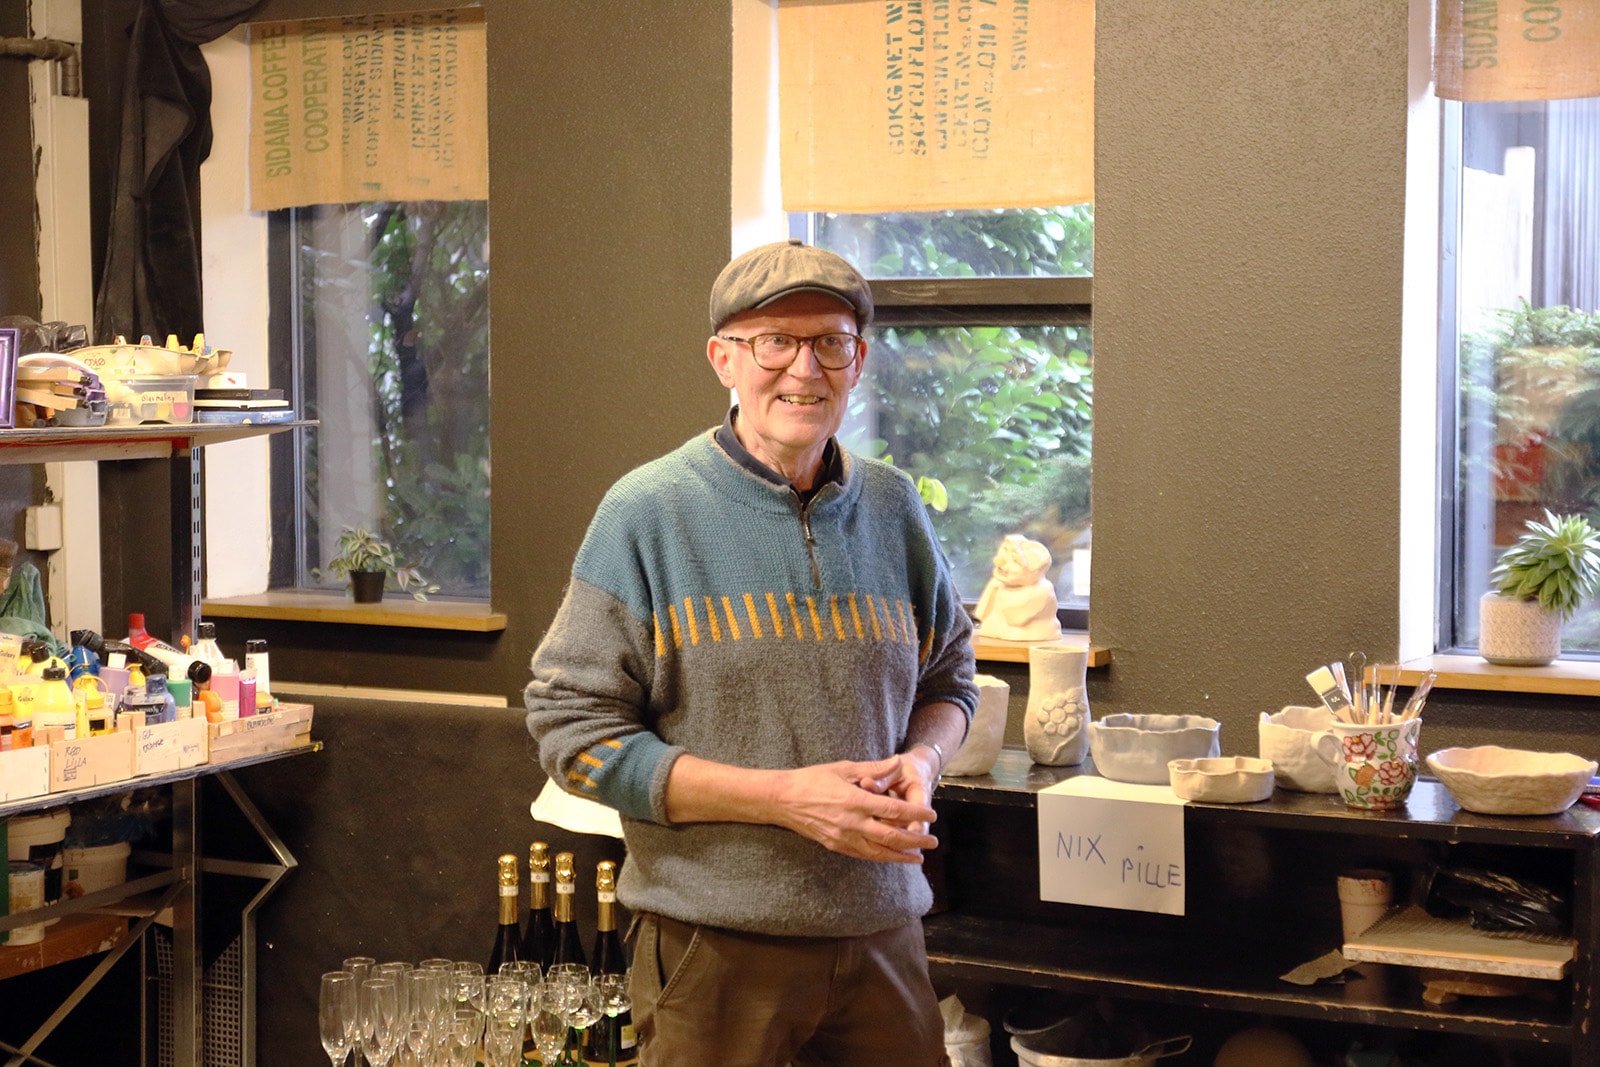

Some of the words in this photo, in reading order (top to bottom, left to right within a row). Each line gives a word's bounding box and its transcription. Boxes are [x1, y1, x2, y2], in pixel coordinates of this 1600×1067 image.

[261, 25, 289, 100] COFFEE
[342, 34, 351, 59] OF
[353, 34, 368, 122] WASHED
[393, 18, 405, 120] FAIRTRADE
[263, 104, 292, 177] SIDAMA
[366, 88, 381, 167] COFFEE
[1056, 831, 1106, 865] NIX
